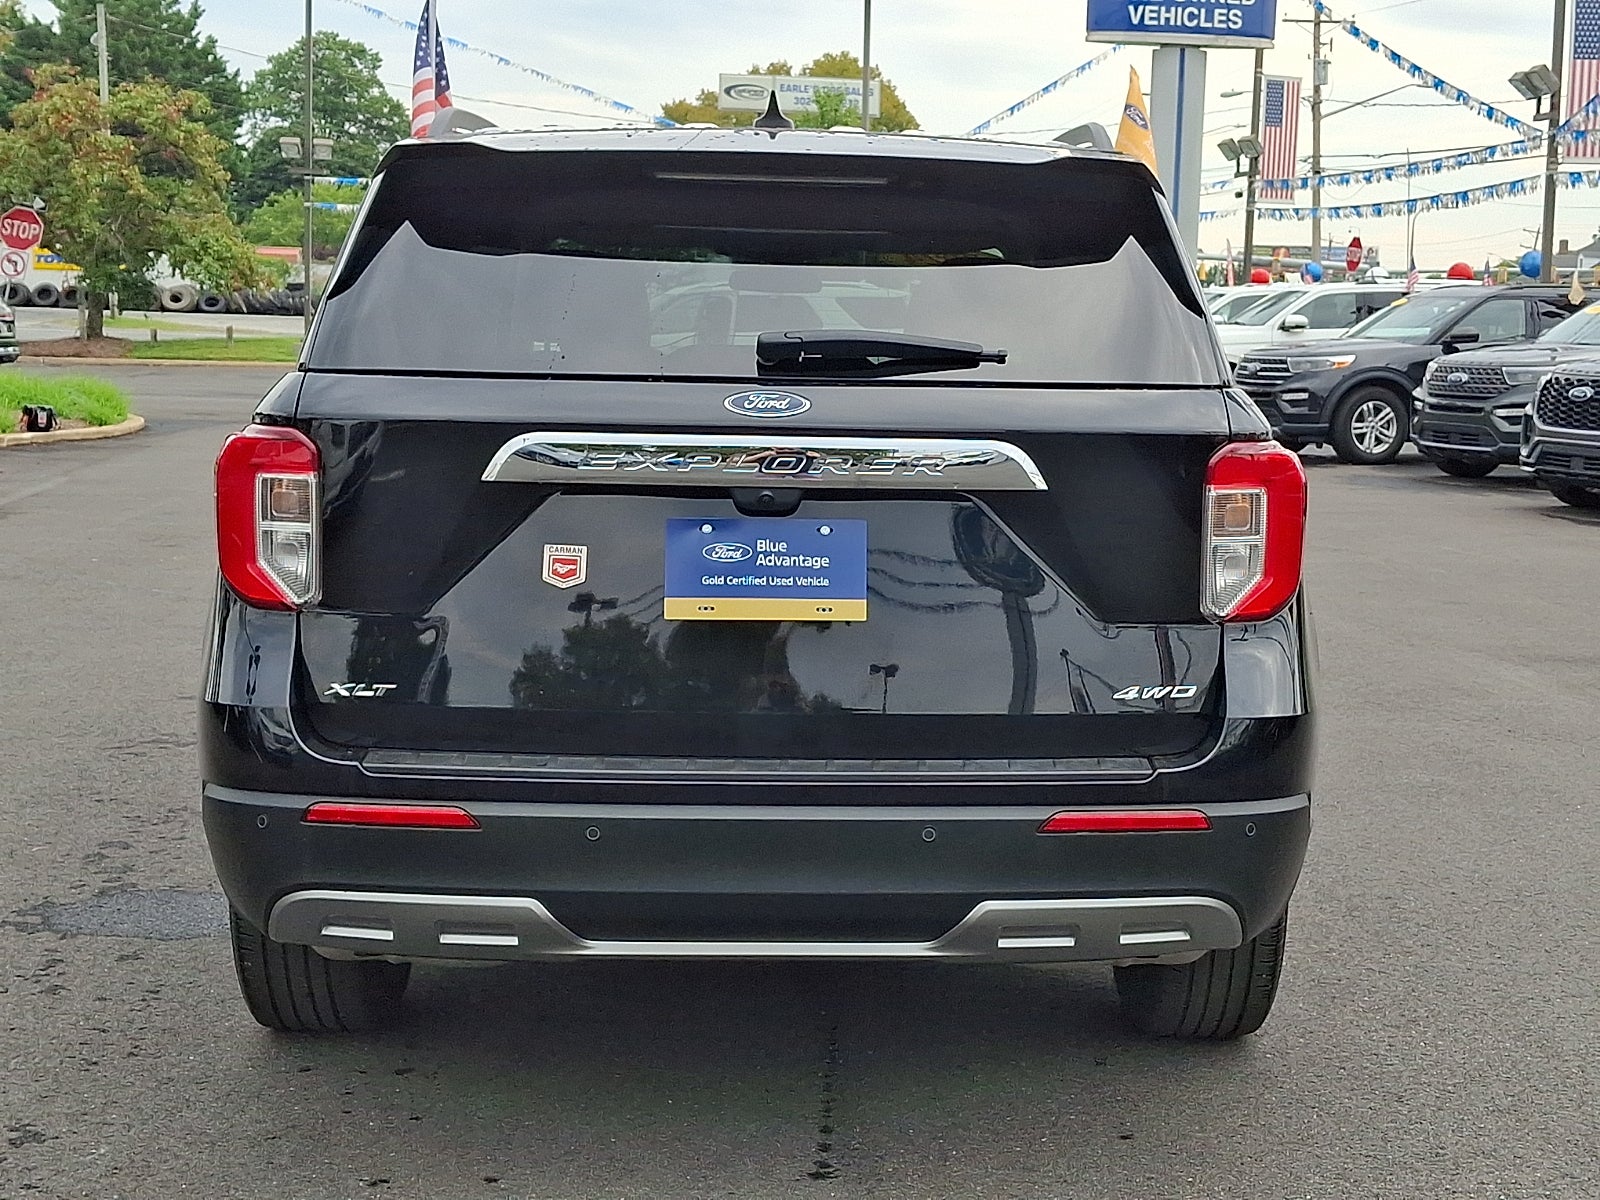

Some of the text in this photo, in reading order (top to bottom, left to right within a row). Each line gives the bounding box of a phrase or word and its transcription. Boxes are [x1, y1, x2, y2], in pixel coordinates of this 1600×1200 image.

[1128, 5, 1243, 29] VEHICLES
[1, 218, 40, 240] STOP
[743, 393, 791, 410] Ford
[576, 450, 945, 476] EXPLORER
[548, 545, 583, 554] CARMAN
[711, 539, 788, 559] Ford Blue
[756, 553, 830, 569] Advantage
[701, 575, 830, 588] Gold Certified Used Vehicle
[323, 683, 397, 697] XLT
[1112, 685, 1198, 700] 4WD
